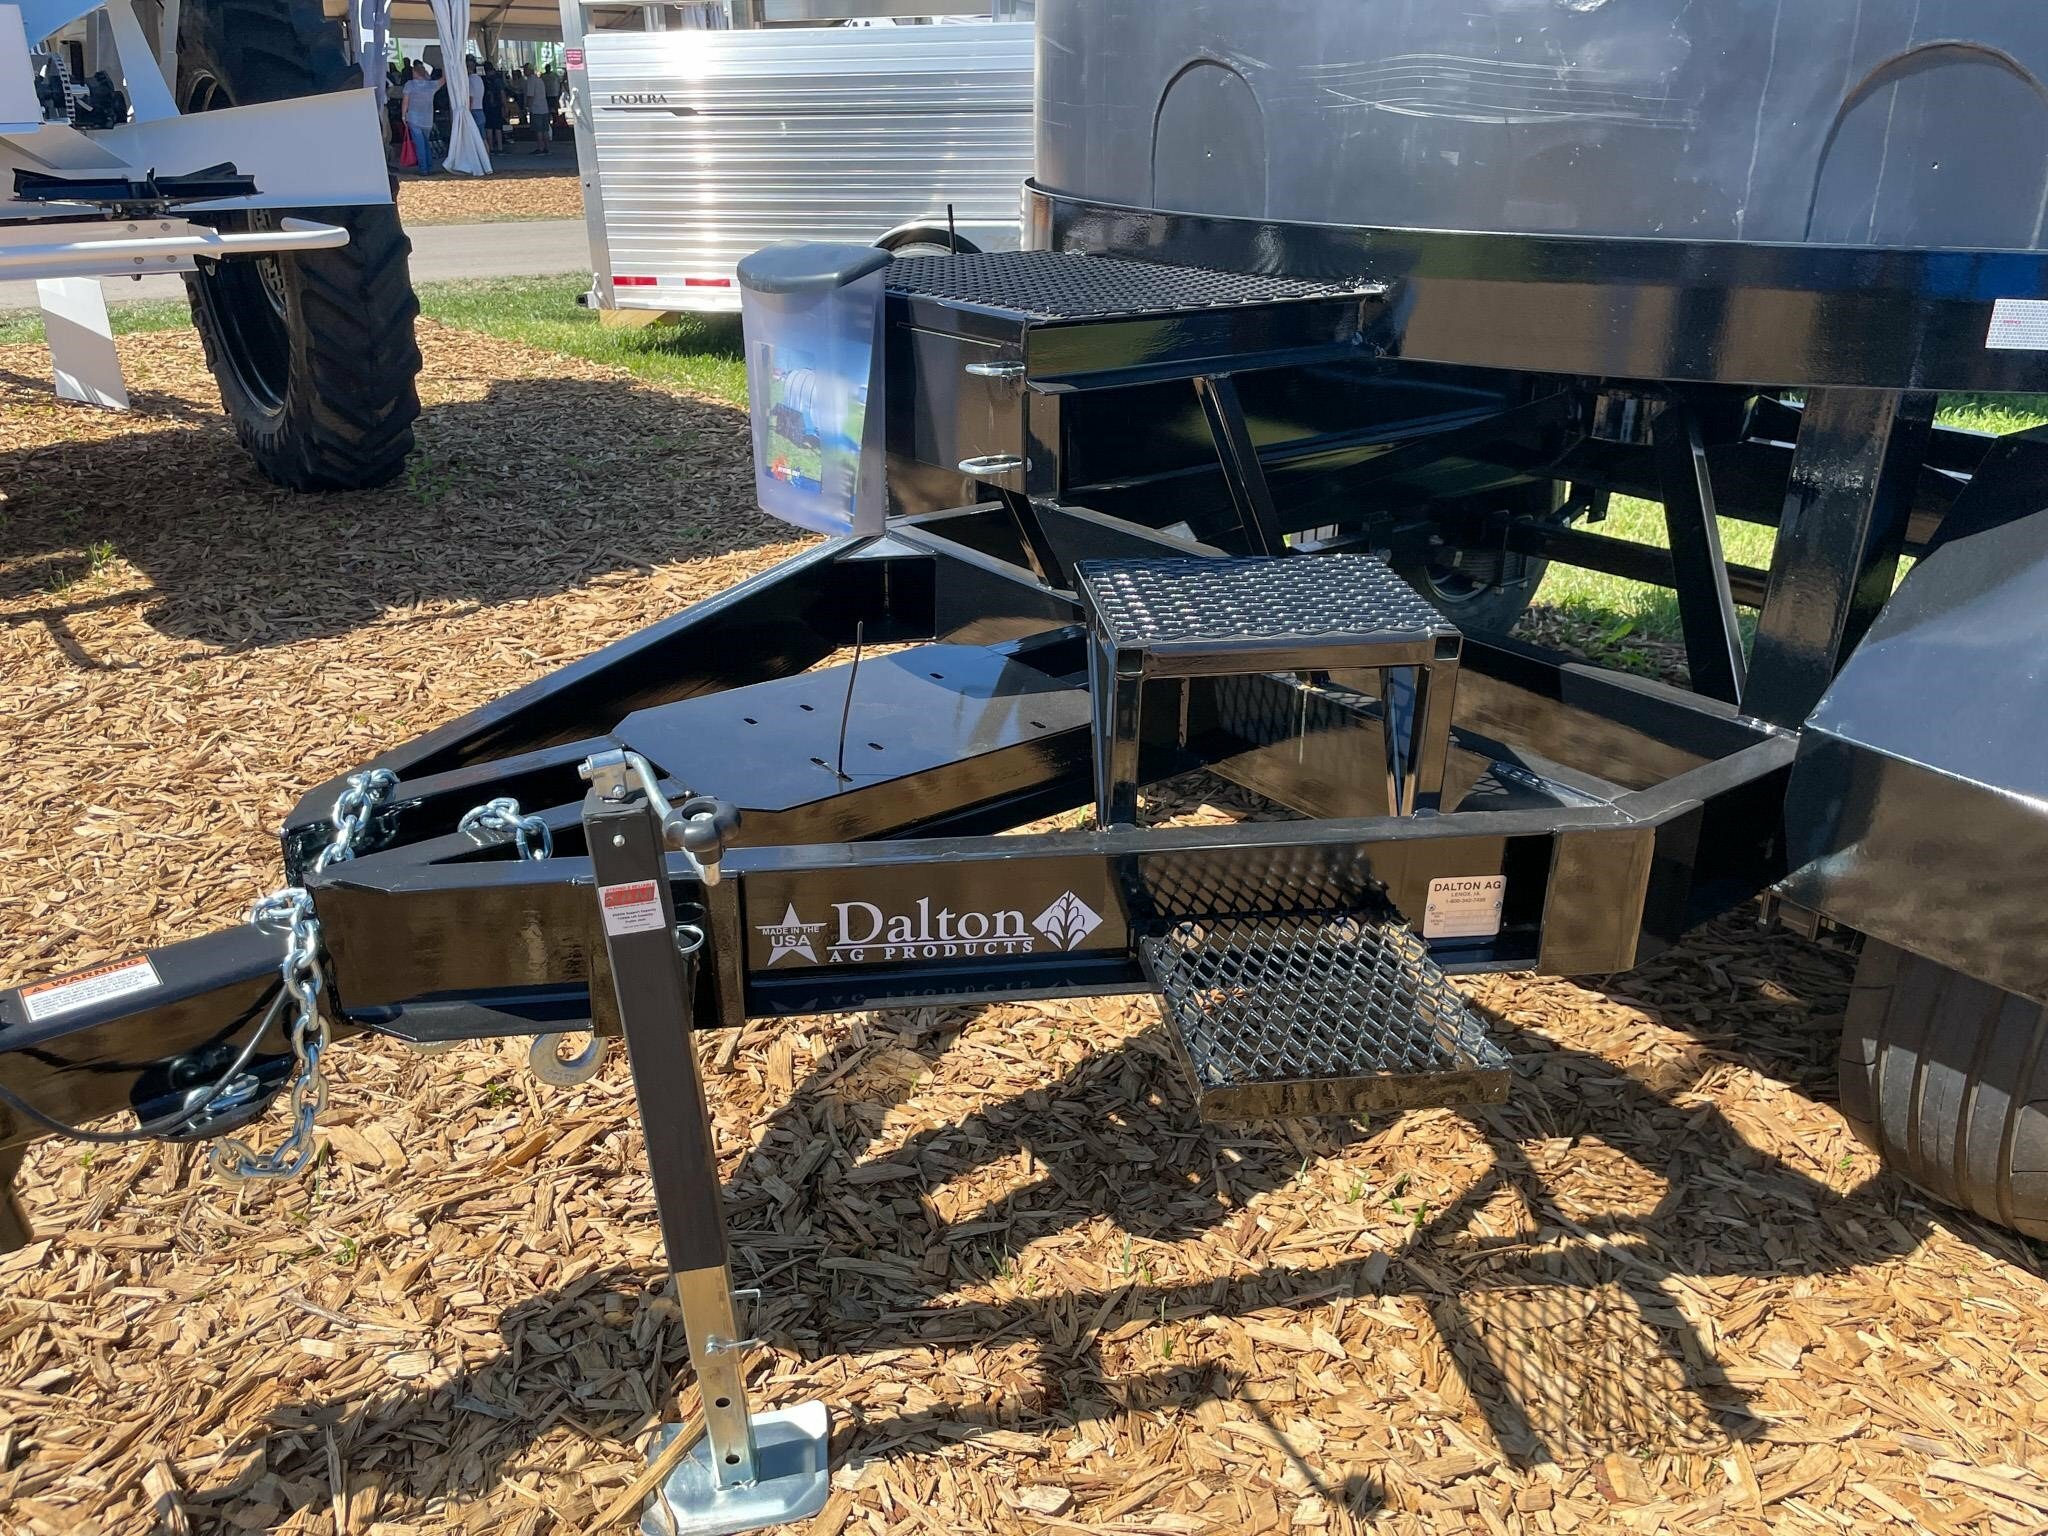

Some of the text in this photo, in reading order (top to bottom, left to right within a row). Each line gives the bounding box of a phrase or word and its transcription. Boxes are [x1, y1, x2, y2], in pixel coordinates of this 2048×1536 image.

[611, 93, 668, 104] ENDURA
[1434, 880, 1502, 892] DALTON AG
[830, 896, 1029, 946] Dalton
[803, 925, 820, 933] THE
[770, 934, 811, 947] USA
[829, 939, 1033, 963] AG PRODUCTS
[50, 959, 140, 987] WARNING
